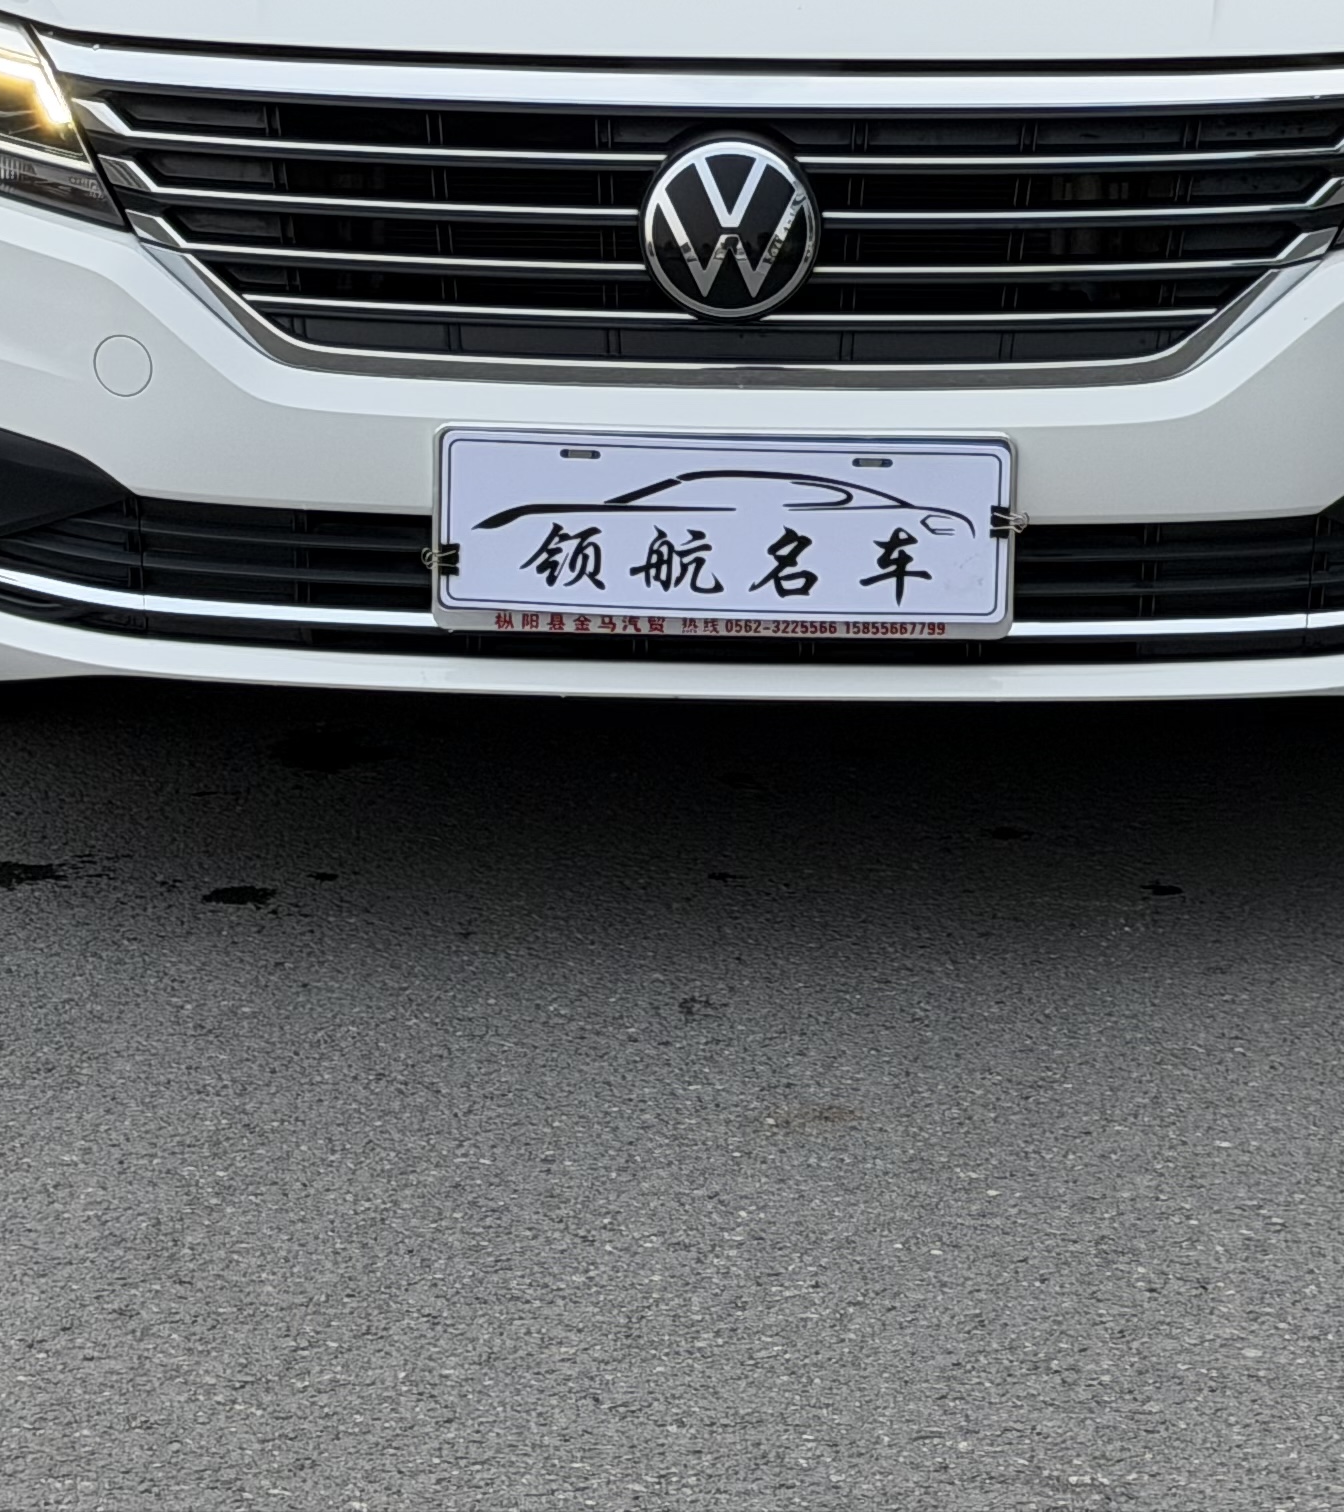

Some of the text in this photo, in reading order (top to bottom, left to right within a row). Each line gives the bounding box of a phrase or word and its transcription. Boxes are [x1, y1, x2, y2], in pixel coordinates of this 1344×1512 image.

[518, 522, 933, 606] 领航名车
[494, 611, 946, 636] 枞阳县金马汽贸 热线 0562-3225566 15855667799
